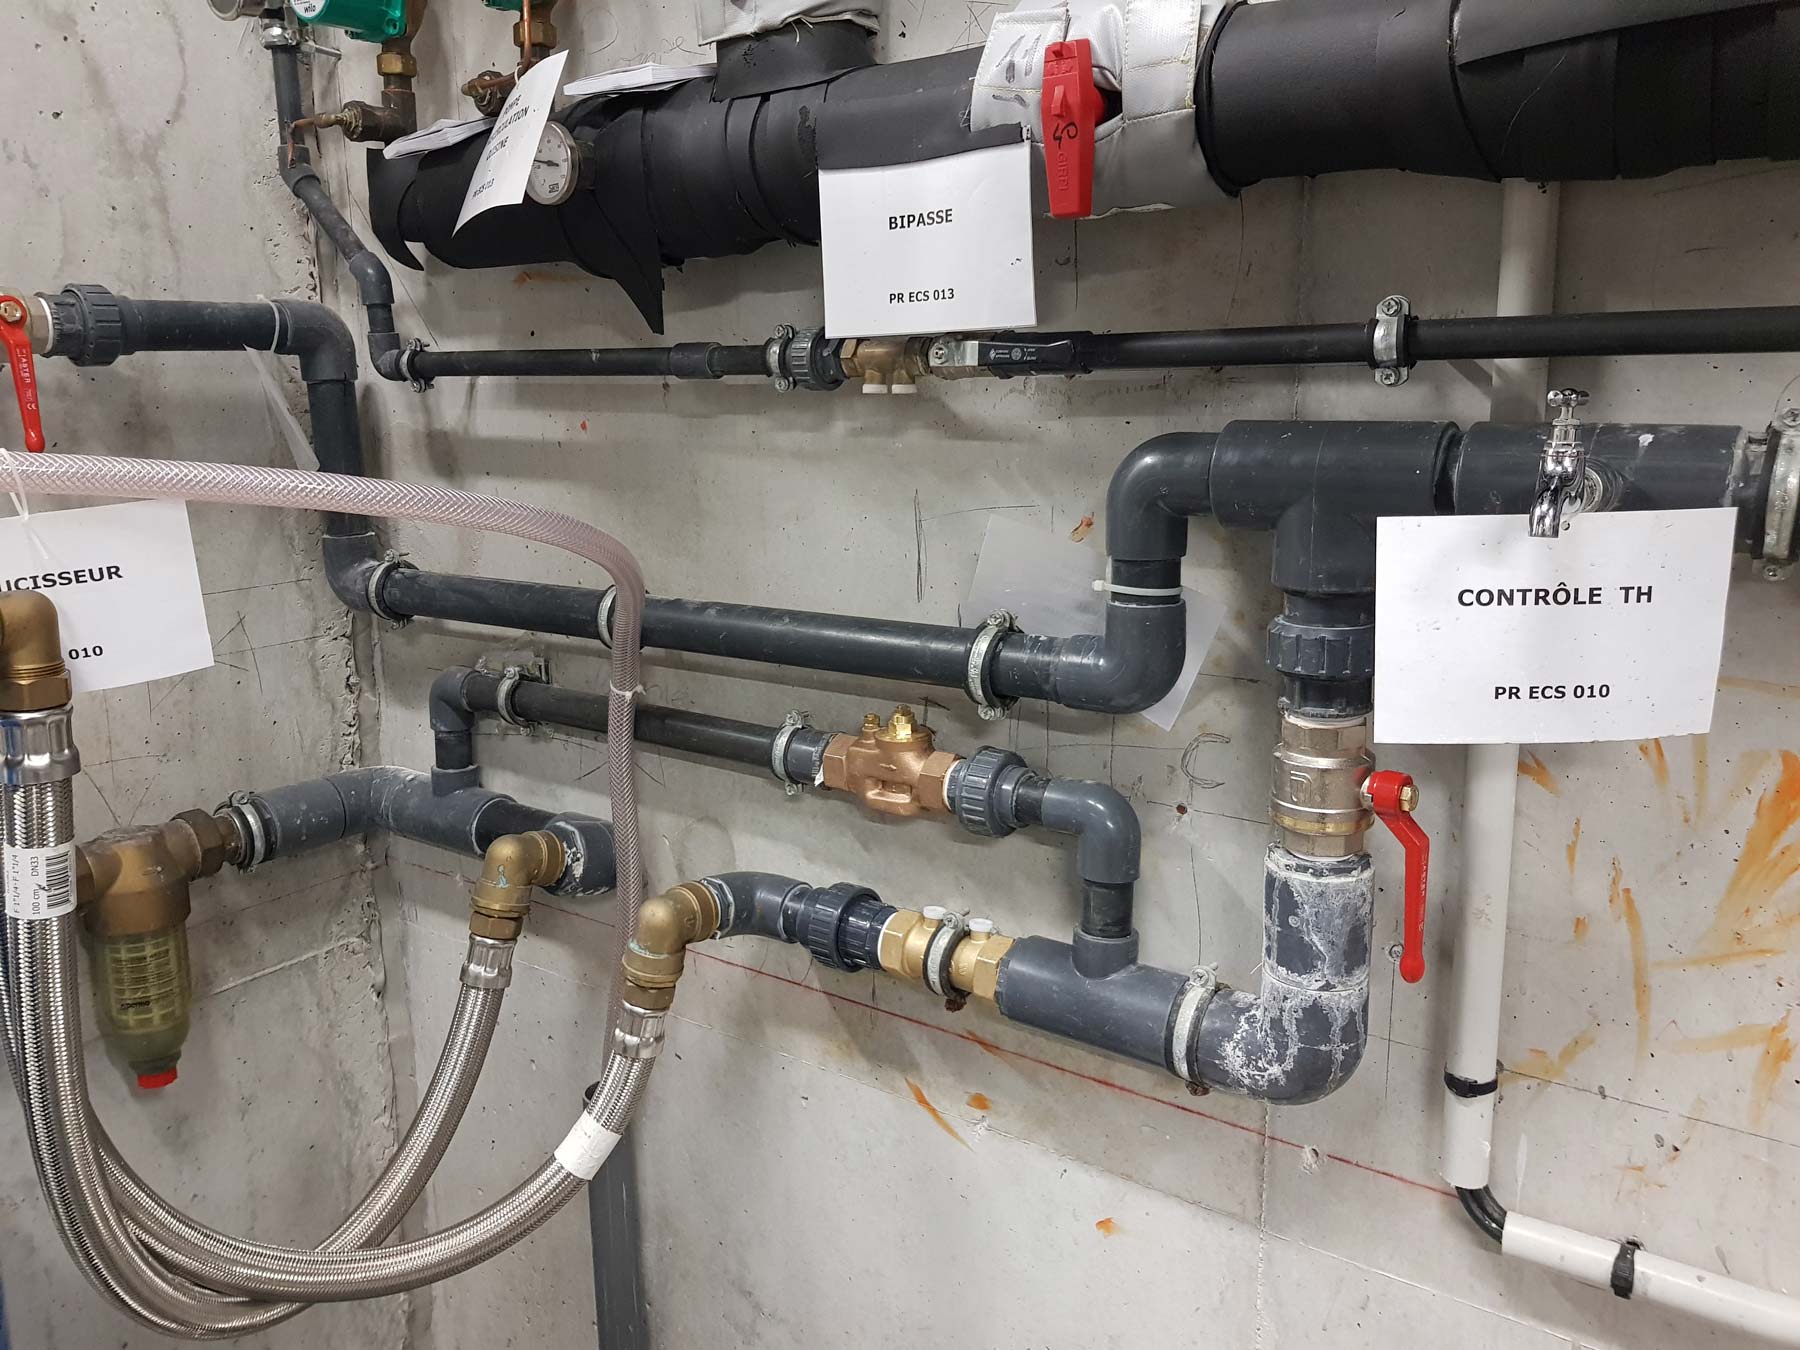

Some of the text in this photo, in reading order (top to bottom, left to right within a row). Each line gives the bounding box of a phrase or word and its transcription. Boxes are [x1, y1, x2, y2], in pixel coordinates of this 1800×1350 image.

[888, 208, 953, 231] BIPASSE
[889, 287, 955, 305] PR ECS 013
[1457, 581, 1653, 607] CONTRÔLE TH
[68, 645, 104, 660] 010
[1494, 684, 1610, 700] PR ECS 010
[30, 856, 41, 915] 100 cm DN33
